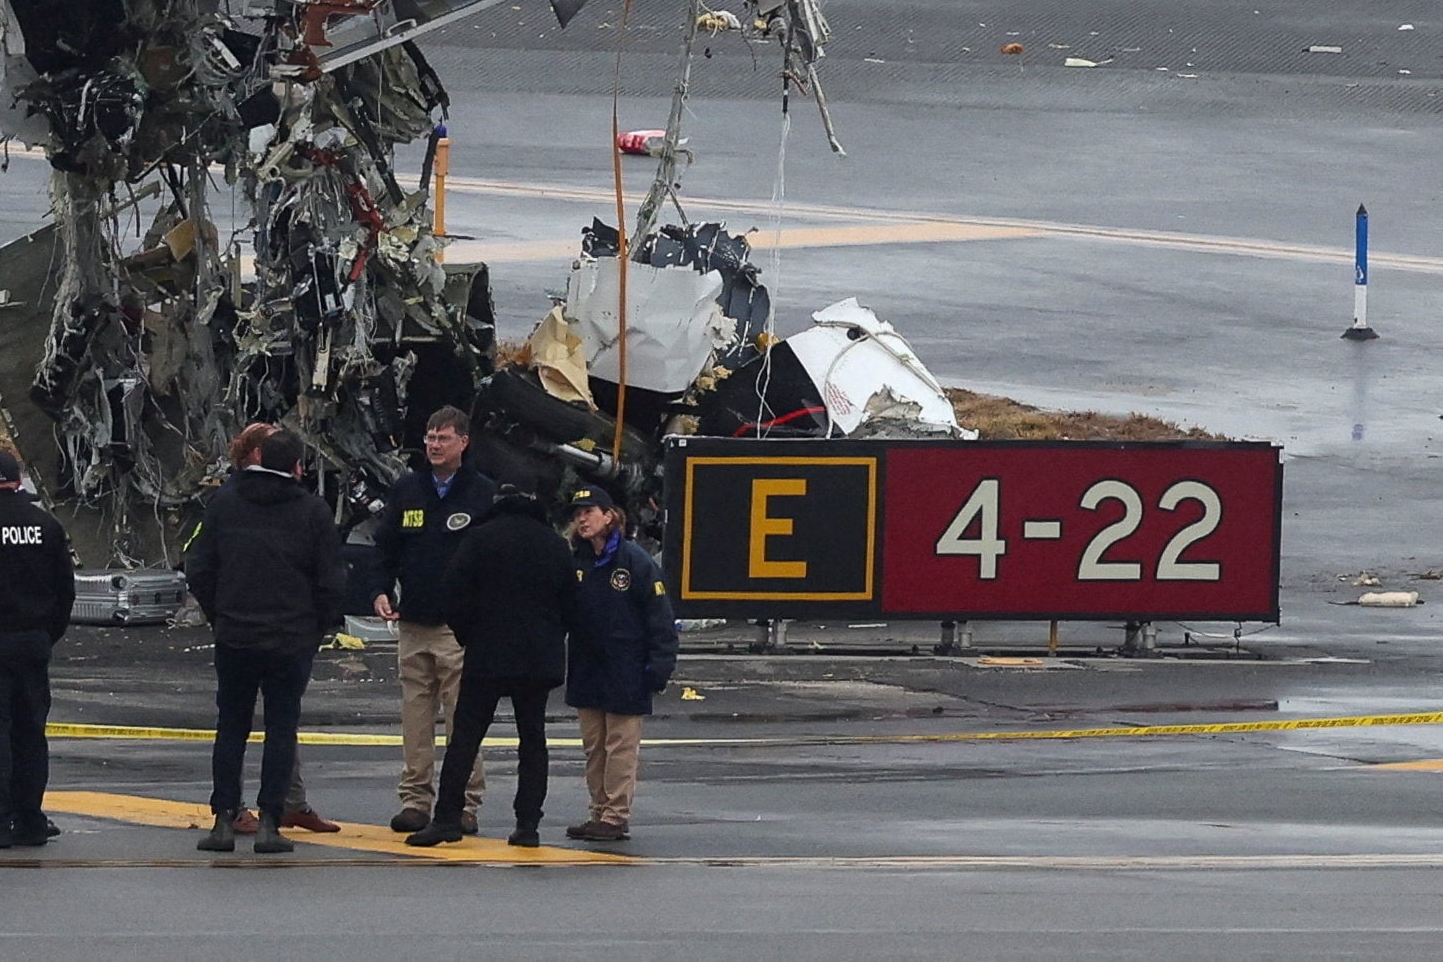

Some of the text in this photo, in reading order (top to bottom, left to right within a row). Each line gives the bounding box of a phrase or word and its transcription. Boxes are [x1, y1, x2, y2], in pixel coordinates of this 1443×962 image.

[1, 526, 43, 545] POLICE
[402, 509, 424, 527] NTSB
[748, 479, 807, 579] E
[936, 479, 1222, 580] 4-22
